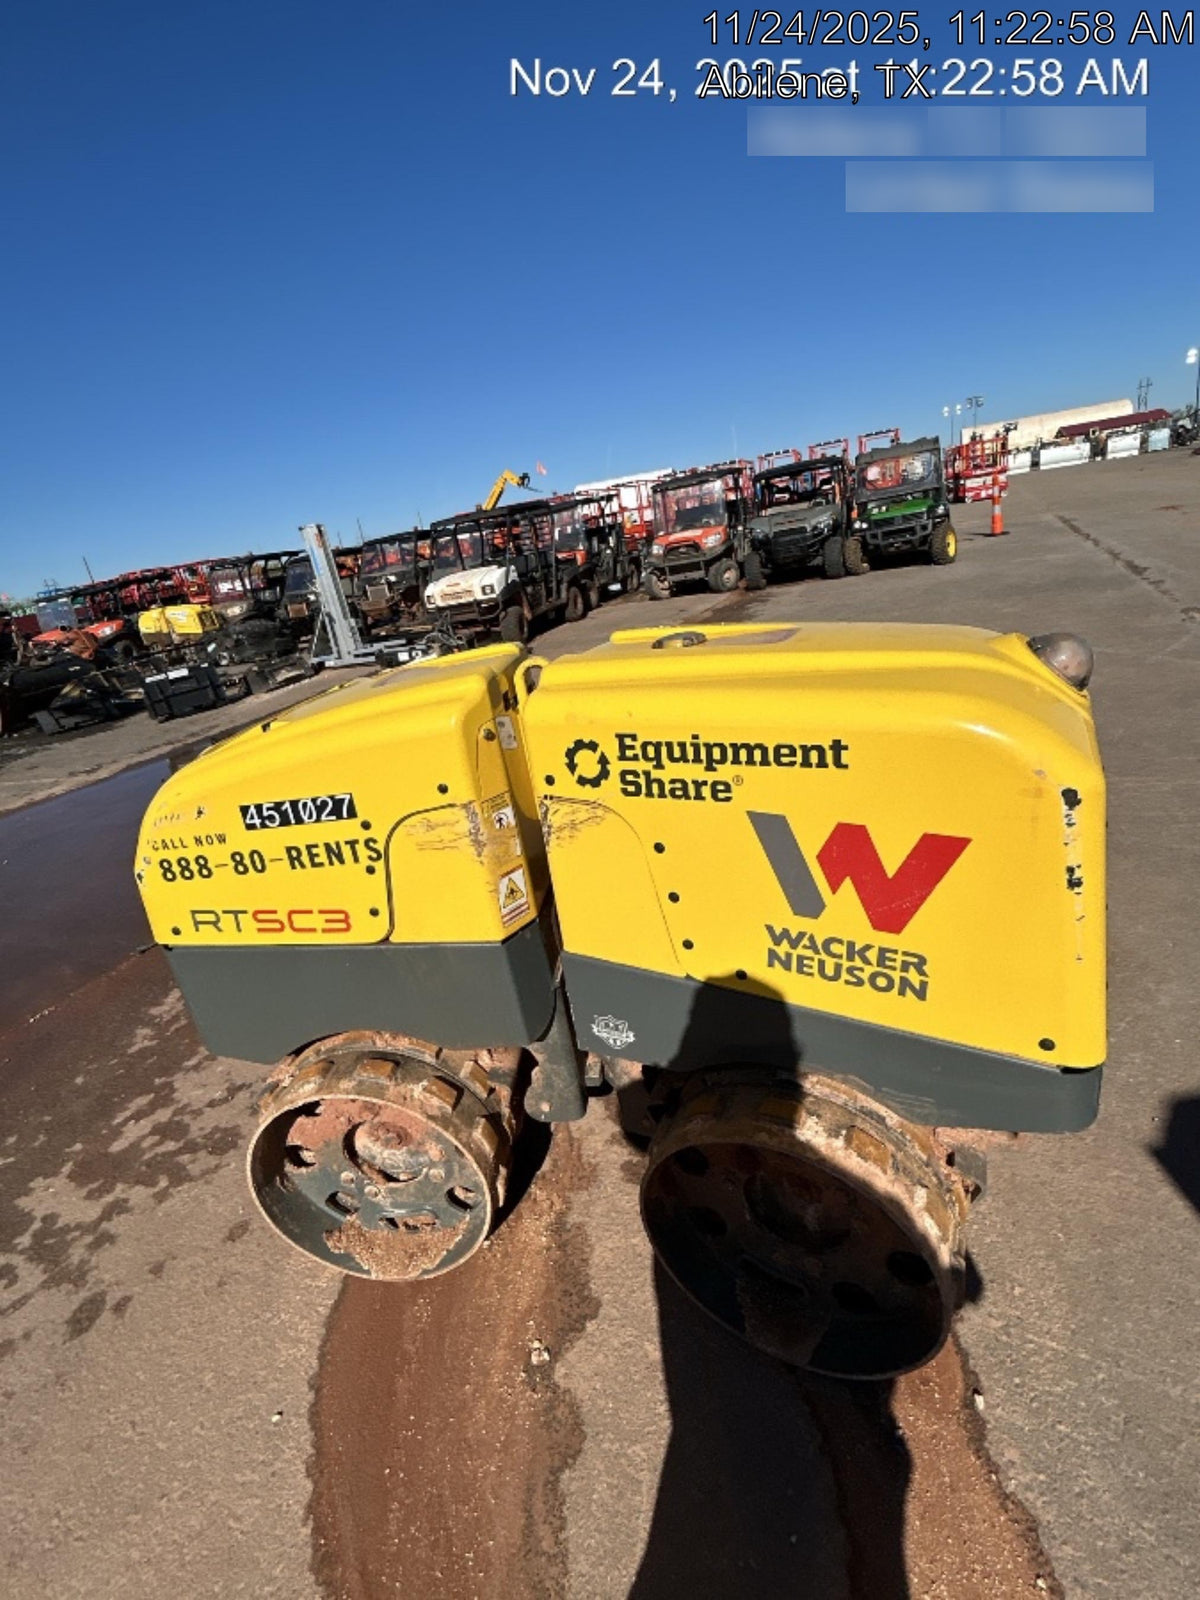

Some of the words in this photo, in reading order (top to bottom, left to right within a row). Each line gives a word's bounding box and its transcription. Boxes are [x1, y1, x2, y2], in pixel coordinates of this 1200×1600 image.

[615, 733, 849, 770] Equipment
[245, 794, 351, 828] 451027
[152, 838, 189, 852] CALL
[193, 833, 227, 847] NOW
[158, 837, 383, 883] 888-80-RENTS
[190, 909, 353, 934] RTSC3
[764, 924, 930, 978] WACKER
[766, 949, 929, 1001] NEUSON
